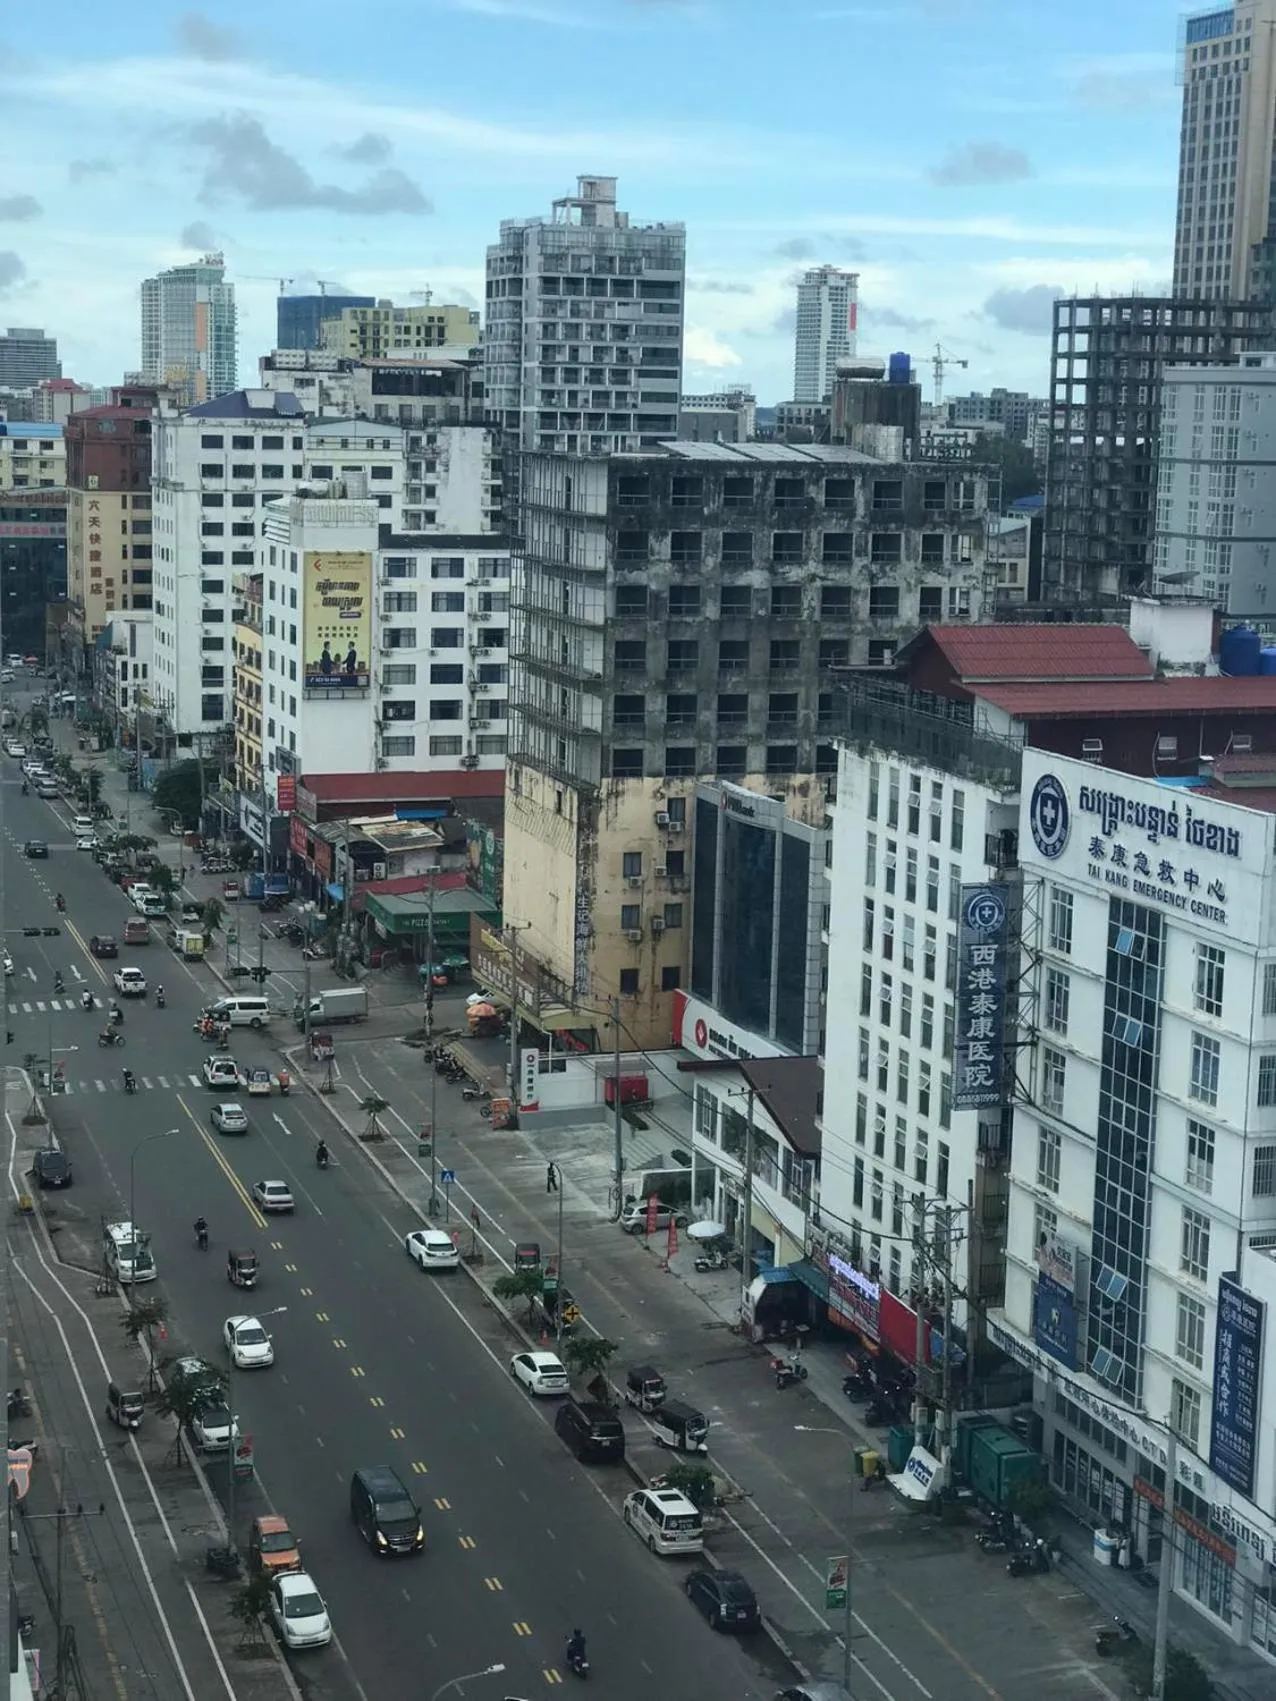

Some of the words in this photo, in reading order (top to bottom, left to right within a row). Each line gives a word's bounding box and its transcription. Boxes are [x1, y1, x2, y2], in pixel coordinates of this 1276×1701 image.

[1087, 862, 1101, 879] TAI
[1105, 868, 1129, 889] KANG
[1133, 879, 1188, 911] EMERGENCY
[1190, 898, 1227, 924] CENTER
[1088, 835, 1227, 903] 泰康急救中心
[964, 943, 999, 1089] 西港泰康医院
